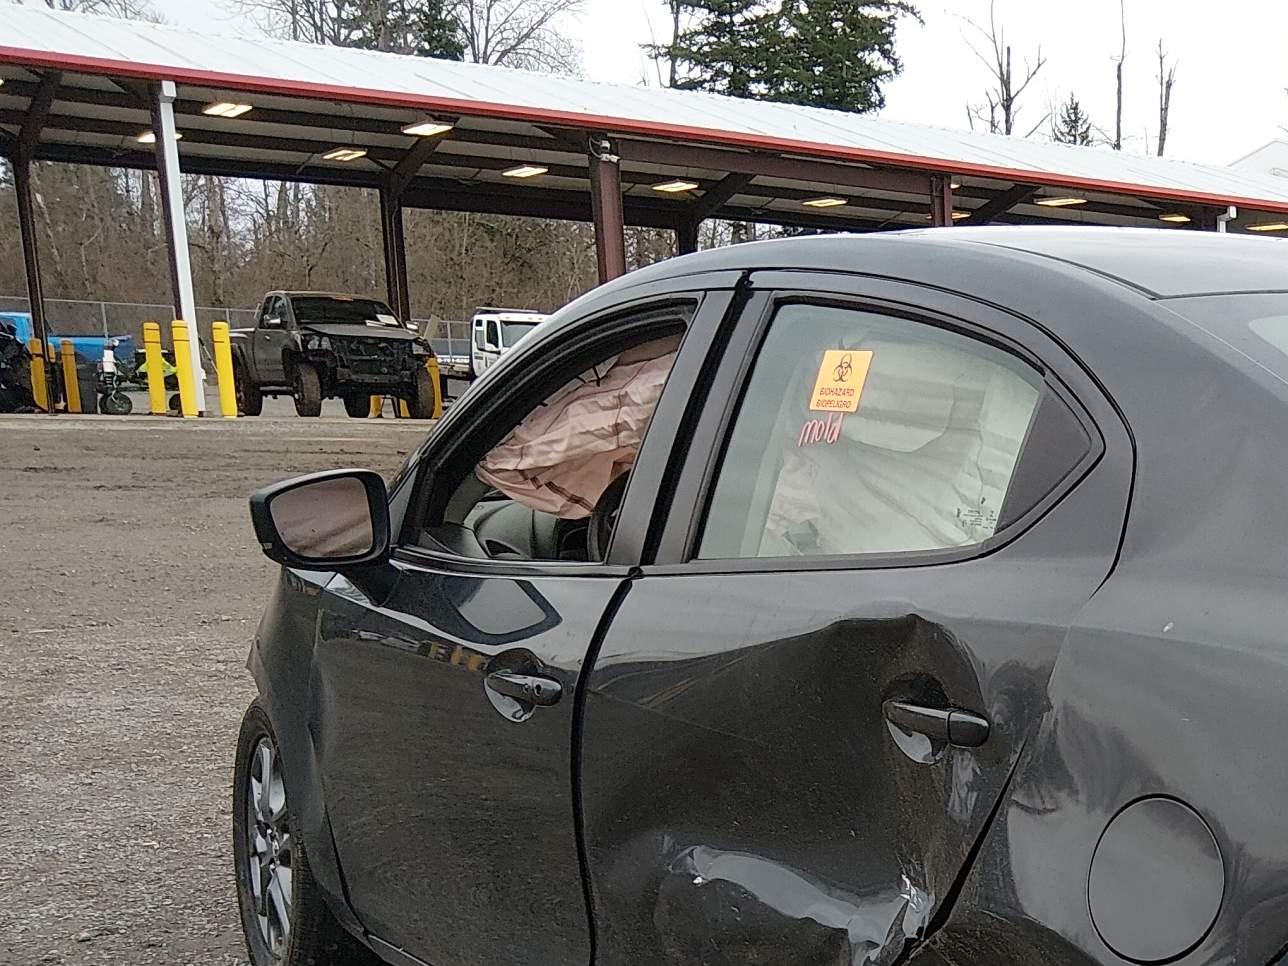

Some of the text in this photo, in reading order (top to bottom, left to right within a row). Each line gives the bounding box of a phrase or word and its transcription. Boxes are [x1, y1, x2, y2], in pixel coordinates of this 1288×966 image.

[819, 387, 855, 397] BIOHAZARD
[815, 399, 851, 409] BIOPELIGRO
[798, 412, 843, 447] mold
